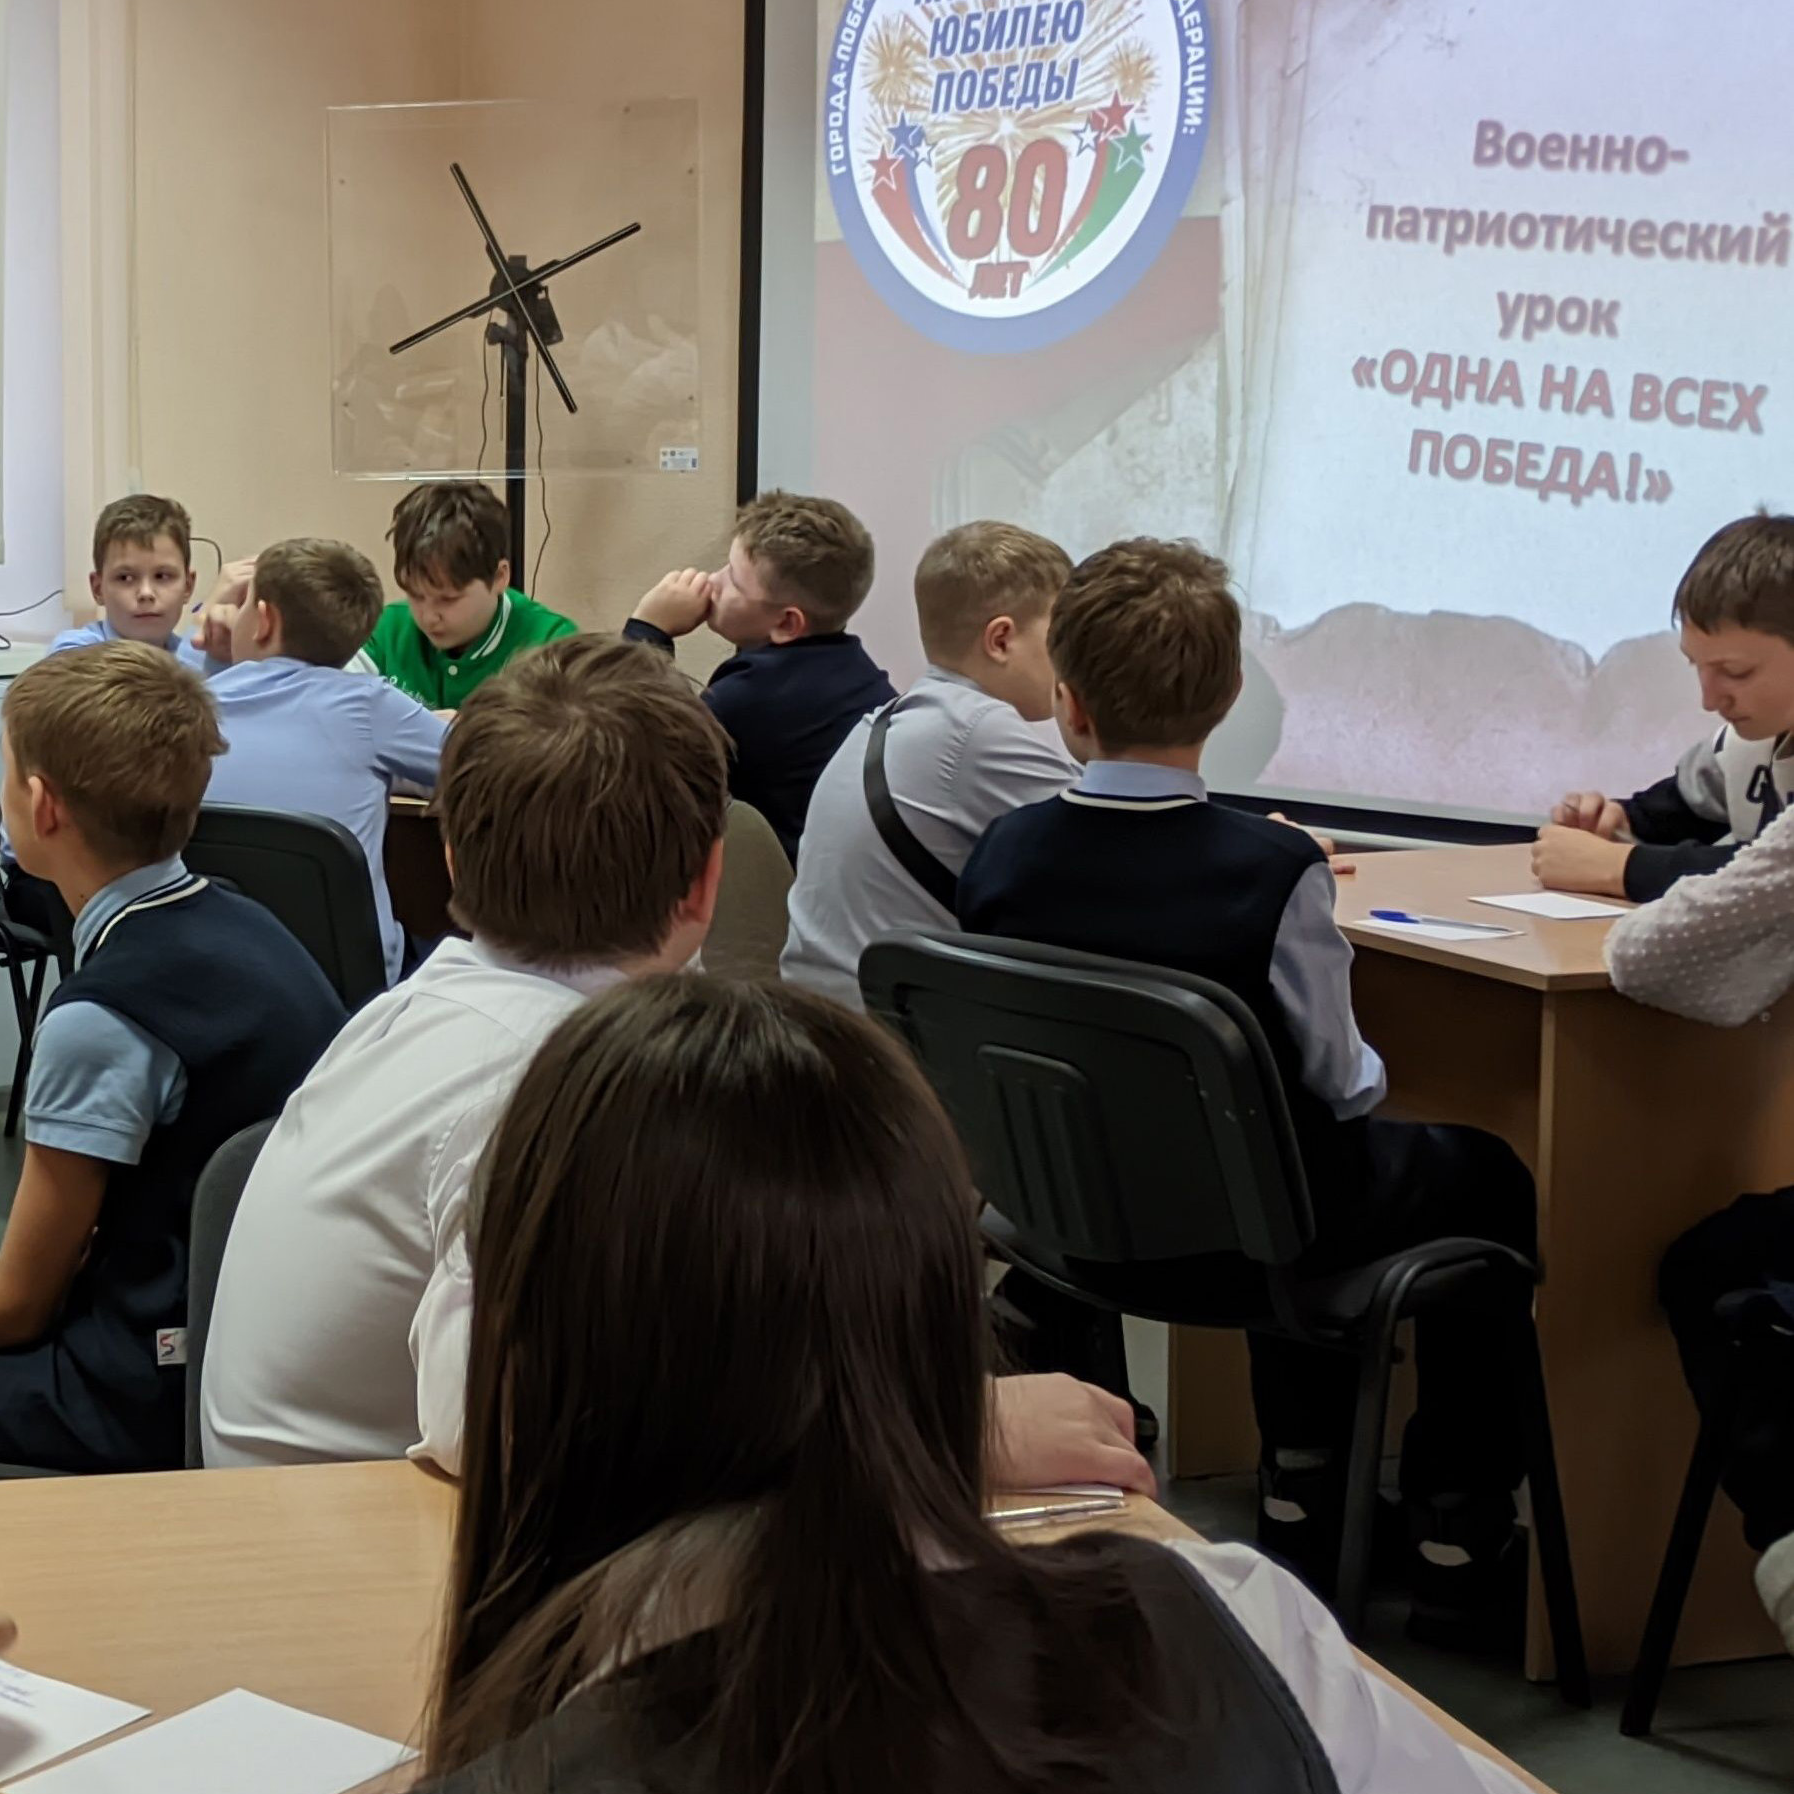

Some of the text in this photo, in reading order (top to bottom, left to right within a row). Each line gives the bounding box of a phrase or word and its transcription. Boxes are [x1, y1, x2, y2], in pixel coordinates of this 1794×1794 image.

[929, 0, 1085, 58] ЮБИЛЕЮ
[932, 60, 1079, 114] ПОБЕДЫ
[1473, 118, 1690, 175] Военно-
[946, 140, 1068, 260] 80
[1366, 204, 1792, 267] патриотический
[968, 261, 1030, 299] ЛЕТ
[1496, 291, 1620, 341] урок
[1351, 348, 1769, 435] «ОДНА НА ВСЕХ
[1407, 429, 1674, 506] ПОБЕДА!»
